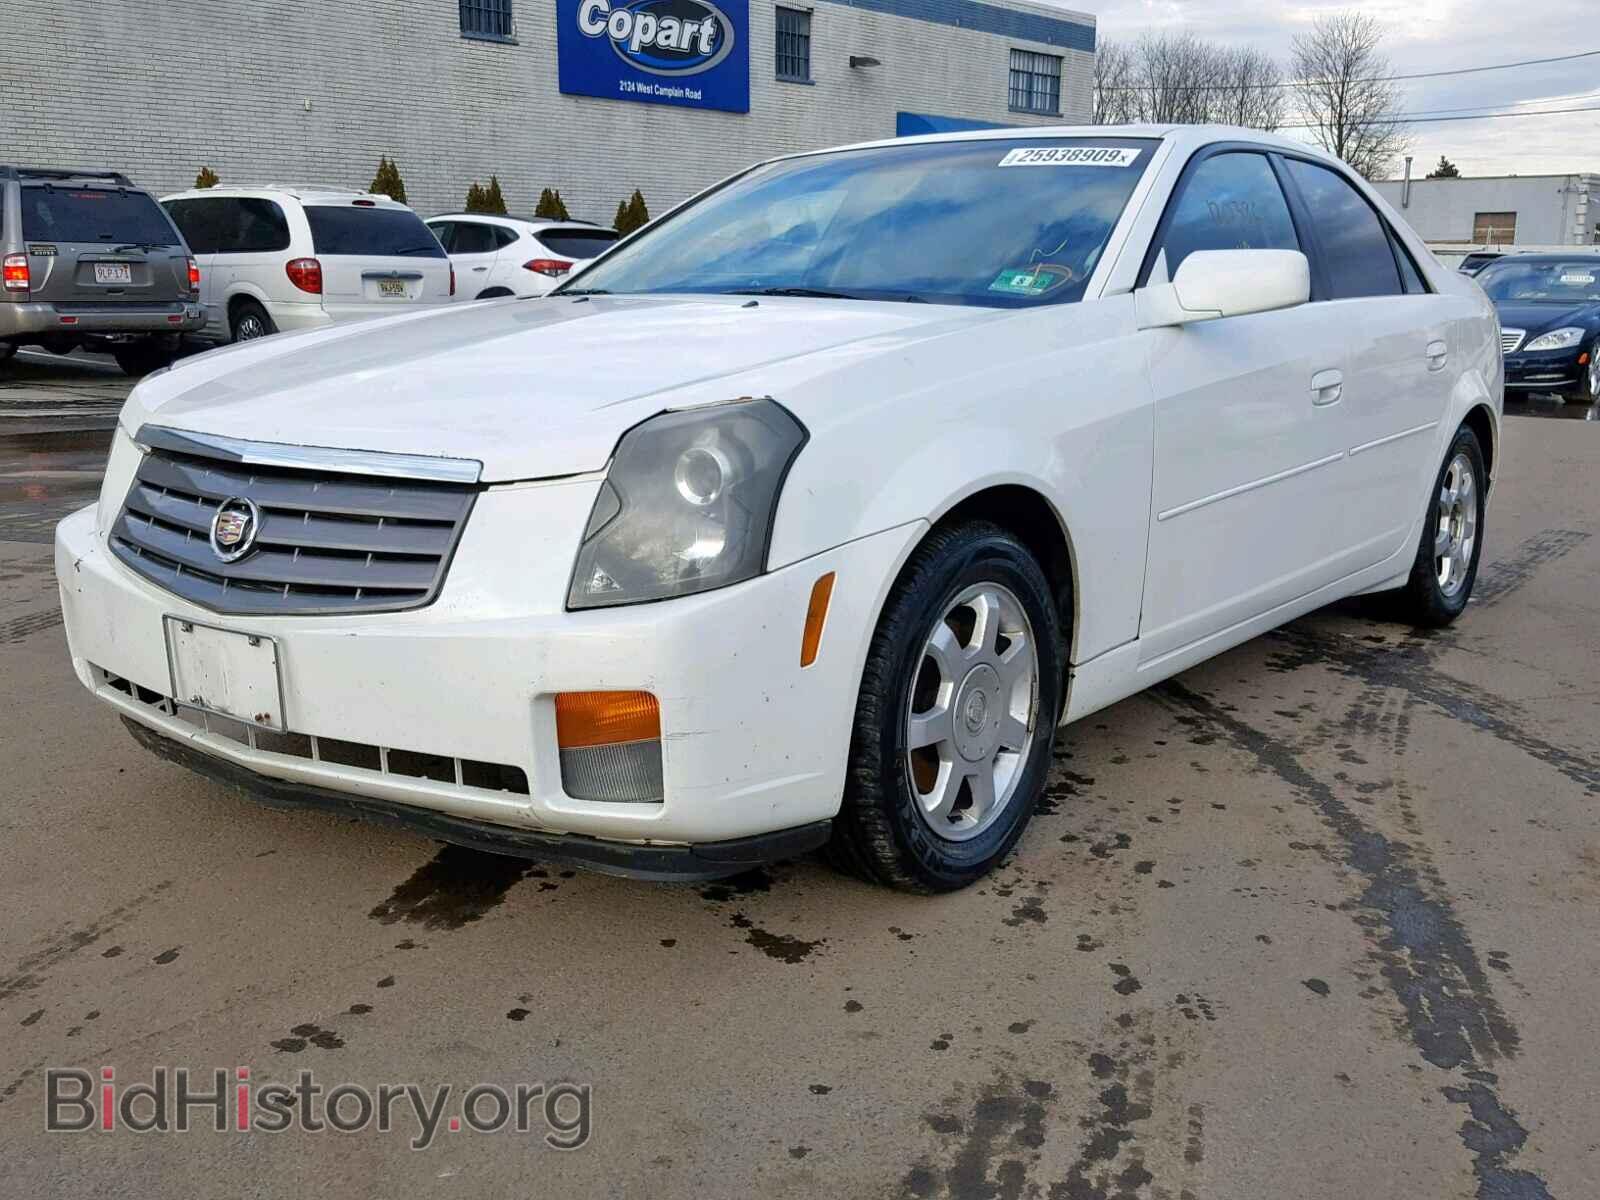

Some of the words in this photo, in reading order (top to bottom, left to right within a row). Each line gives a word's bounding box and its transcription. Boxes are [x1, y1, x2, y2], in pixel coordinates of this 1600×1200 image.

[577, 0, 717, 54] Copart
[619, 80, 635, 92] 2124
[637, 83, 653, 95] West
[654, 85, 684, 99] Camplain
[685, 88, 702, 100] Road
